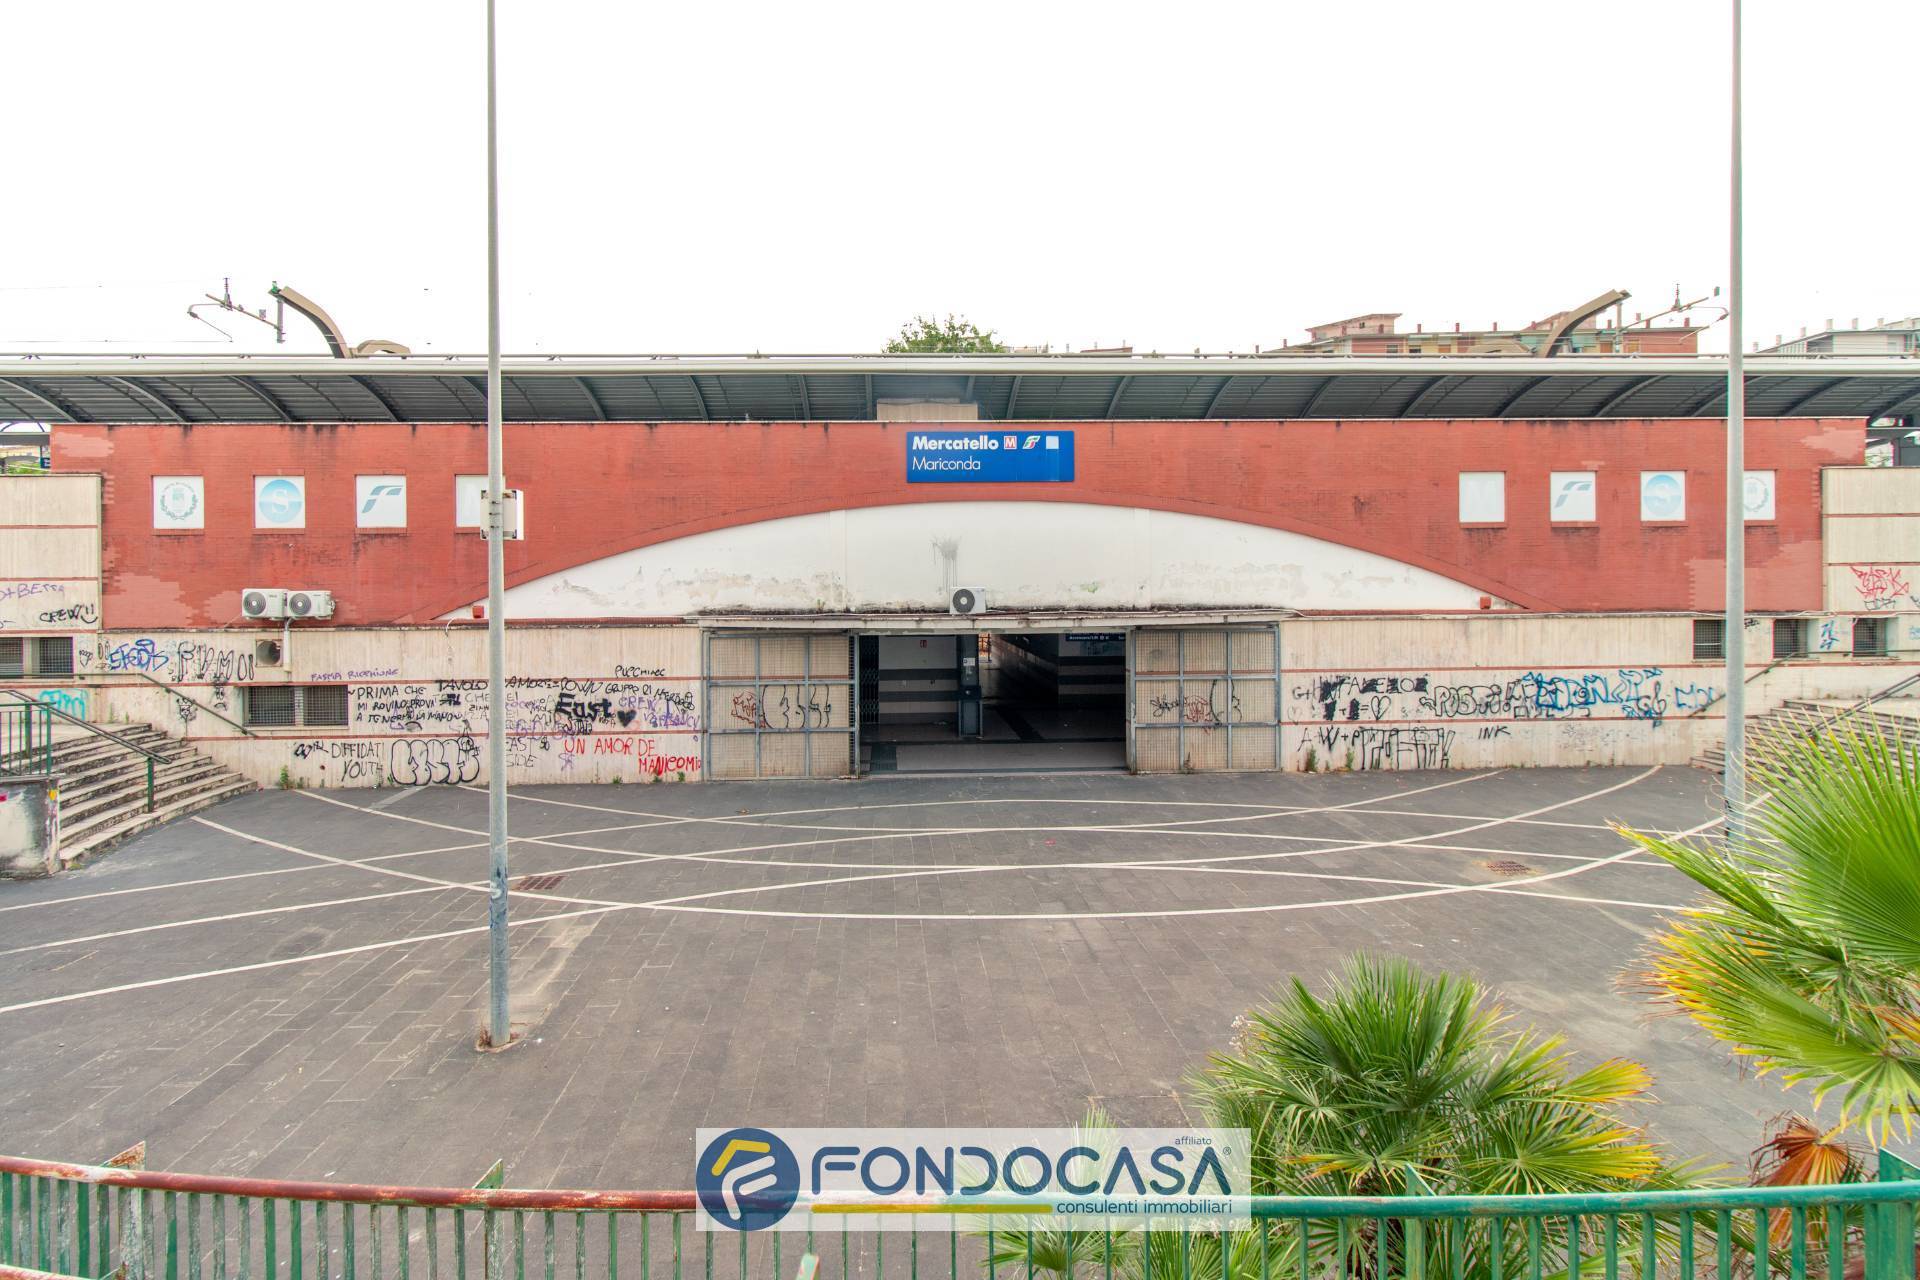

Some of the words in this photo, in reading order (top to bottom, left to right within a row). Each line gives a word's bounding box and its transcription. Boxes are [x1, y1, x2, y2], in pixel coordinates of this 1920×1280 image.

[912, 434, 999, 451] Mercatello
[912, 456, 981, 471] Mariconda
[357, 684, 399, 699] PRIMA
[555, 692, 612, 722] East
[1478, 726, 1511, 740] INK
[564, 738, 586, 755] UN
[594, 737, 633, 756] AMOR
[638, 738, 656, 757] DE
